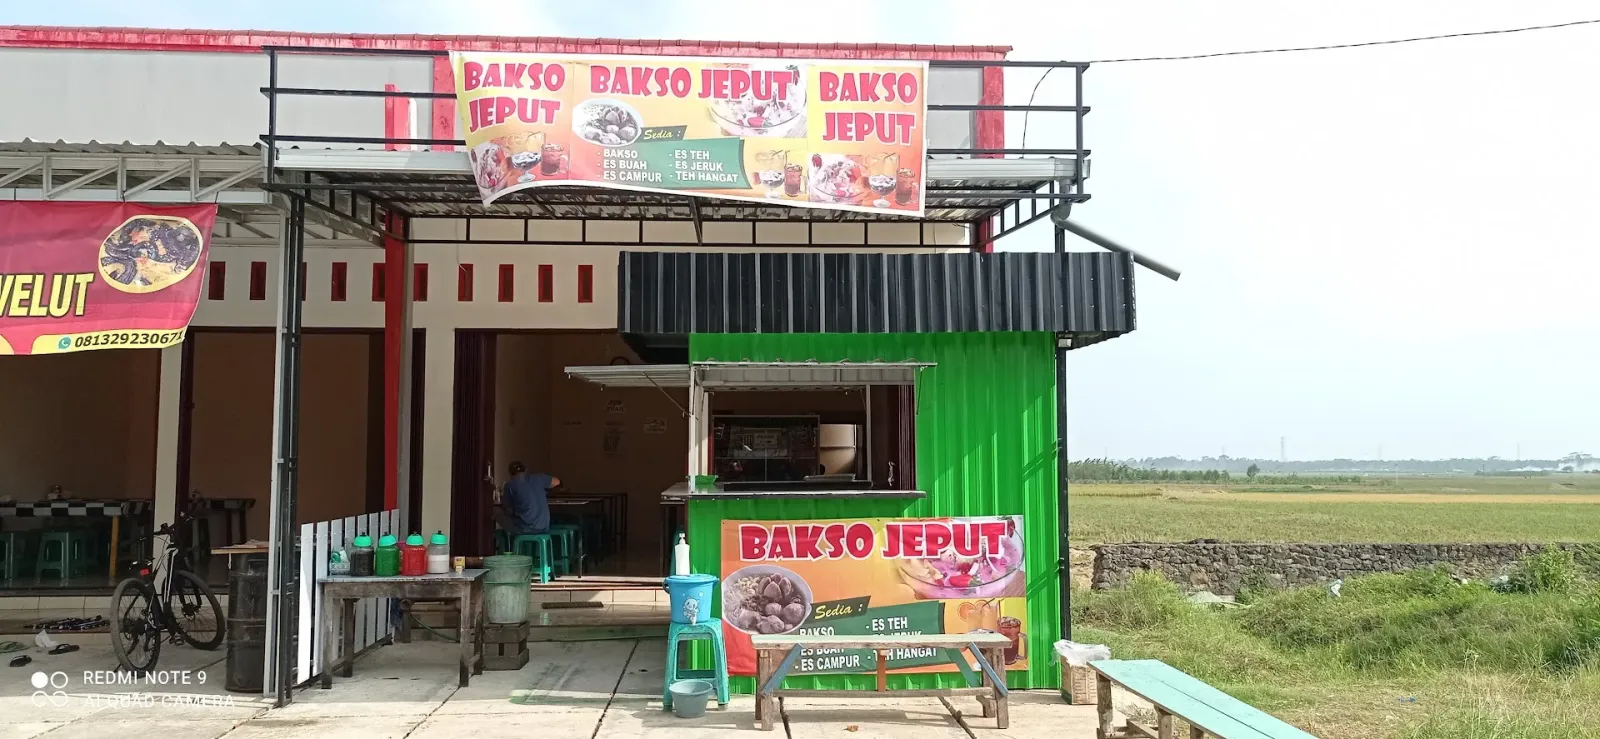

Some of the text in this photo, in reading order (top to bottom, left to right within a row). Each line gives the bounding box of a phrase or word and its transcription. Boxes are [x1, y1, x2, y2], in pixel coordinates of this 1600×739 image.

[463, 61, 566, 92] BAKSO
[590, 65, 793, 101] BAKSO JEPUT
[819, 71, 918, 104] BAKSO
[468, 96, 561, 133] JEPUT
[643, 129, 673, 140] Sedia
[822, 112, 915, 144] JEPUT
[603, 148, 638, 159] BAKSO
[674, 149, 710, 161] ES TEH
[603, 159, 647, 170] ES BUAH
[675, 160, 723, 172] ES JERUK
[603, 170, 662, 183] ES CAMPUR
[675, 171, 739, 183] TEH HANGAT
[74, 330, 183, 348] 081329230671
[739, 522, 1007, 561] BAKSO JEPUT
[814, 604, 853, 620] Sedia
[872, 616, 908, 632] ES TEH
[801, 655, 860, 671] ES CAMPUR
